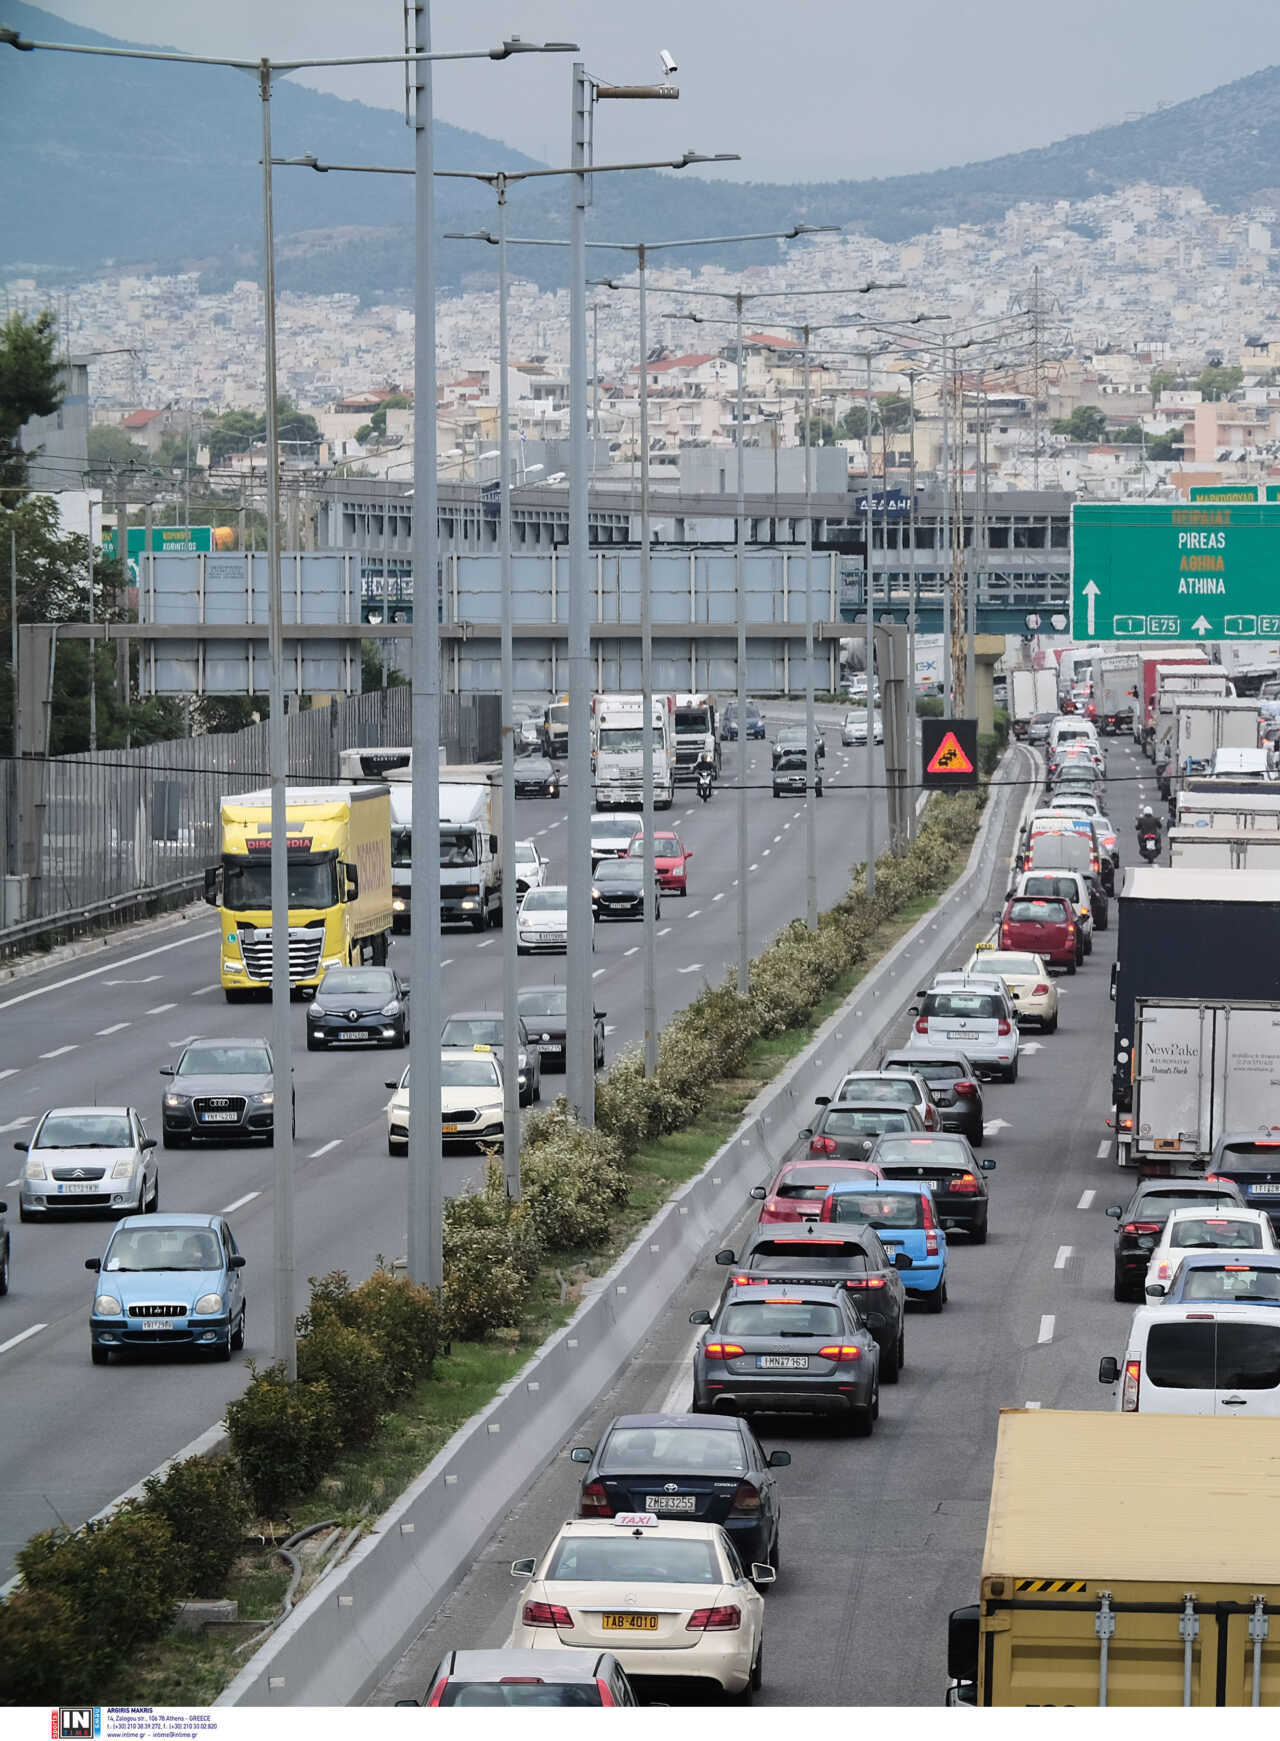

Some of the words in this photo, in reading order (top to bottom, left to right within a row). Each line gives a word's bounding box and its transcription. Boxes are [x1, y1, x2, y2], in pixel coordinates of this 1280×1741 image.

[1178, 532, 1225, 548] PIREAS
[1180, 555, 1224, 571] ΑΘΗΝΑ
[1178, 578, 1226, 594] ATHINA
[1152, 619, 1176, 631] E75
[620, 1516, 651, 1525] TAXI
